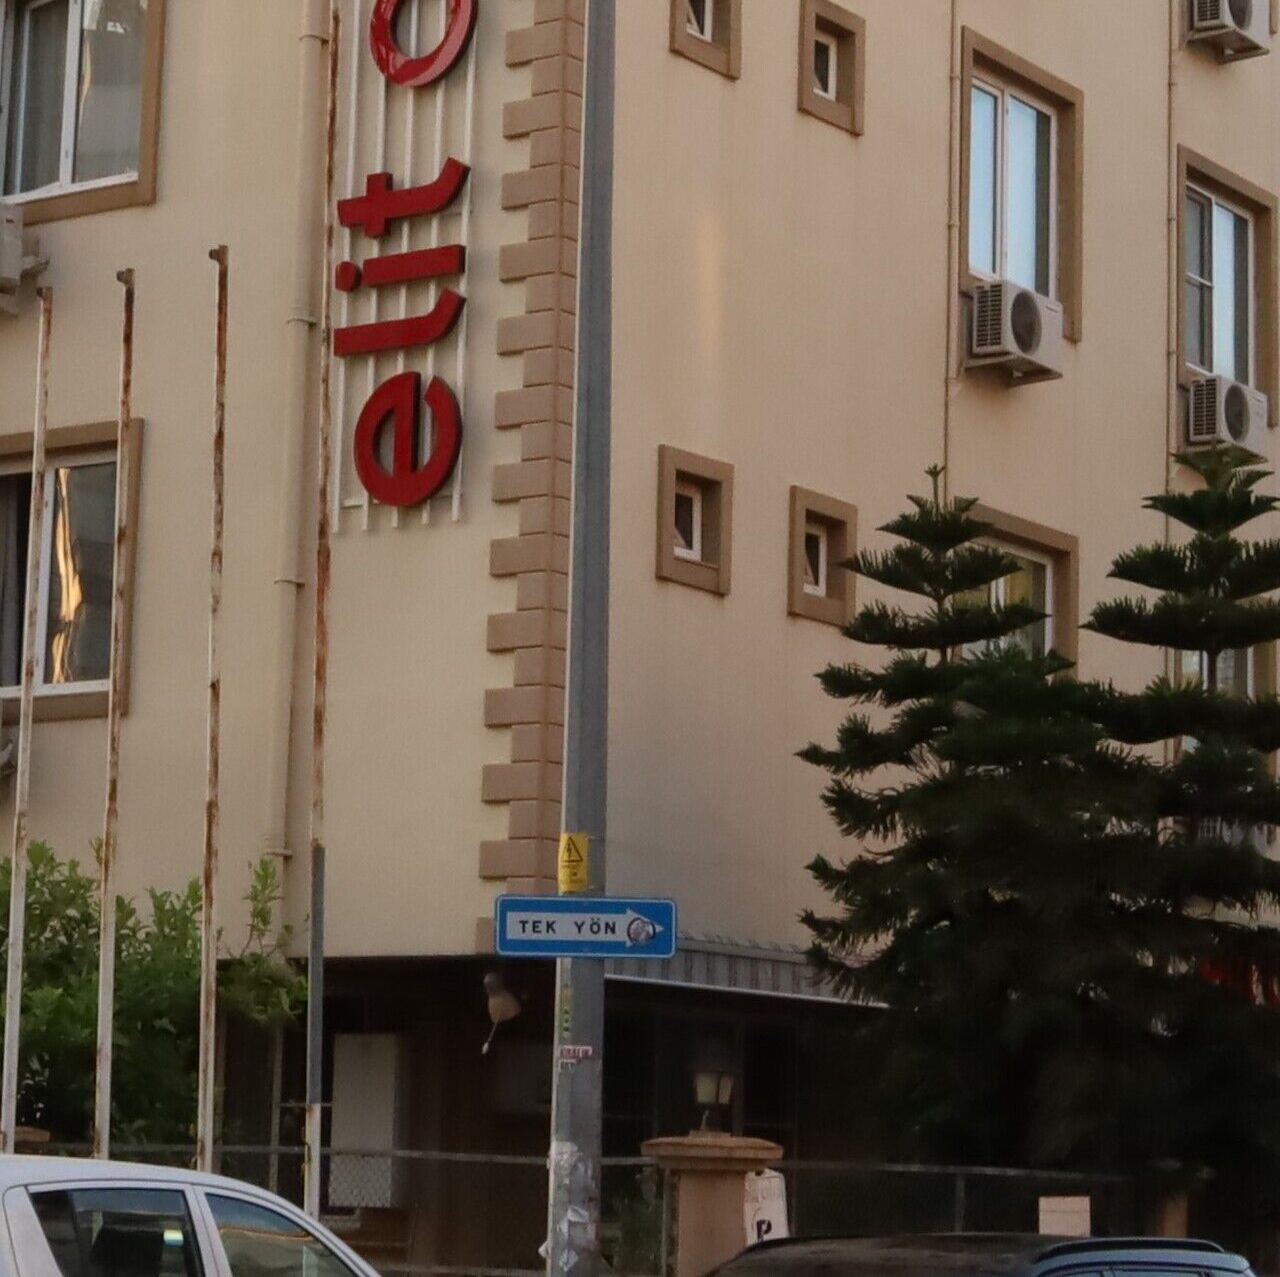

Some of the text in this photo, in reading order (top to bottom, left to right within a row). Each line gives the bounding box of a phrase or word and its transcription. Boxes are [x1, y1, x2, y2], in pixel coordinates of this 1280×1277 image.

[333, 157, 472, 508] elit
[519, 918, 616, 935] TEK YÖN
